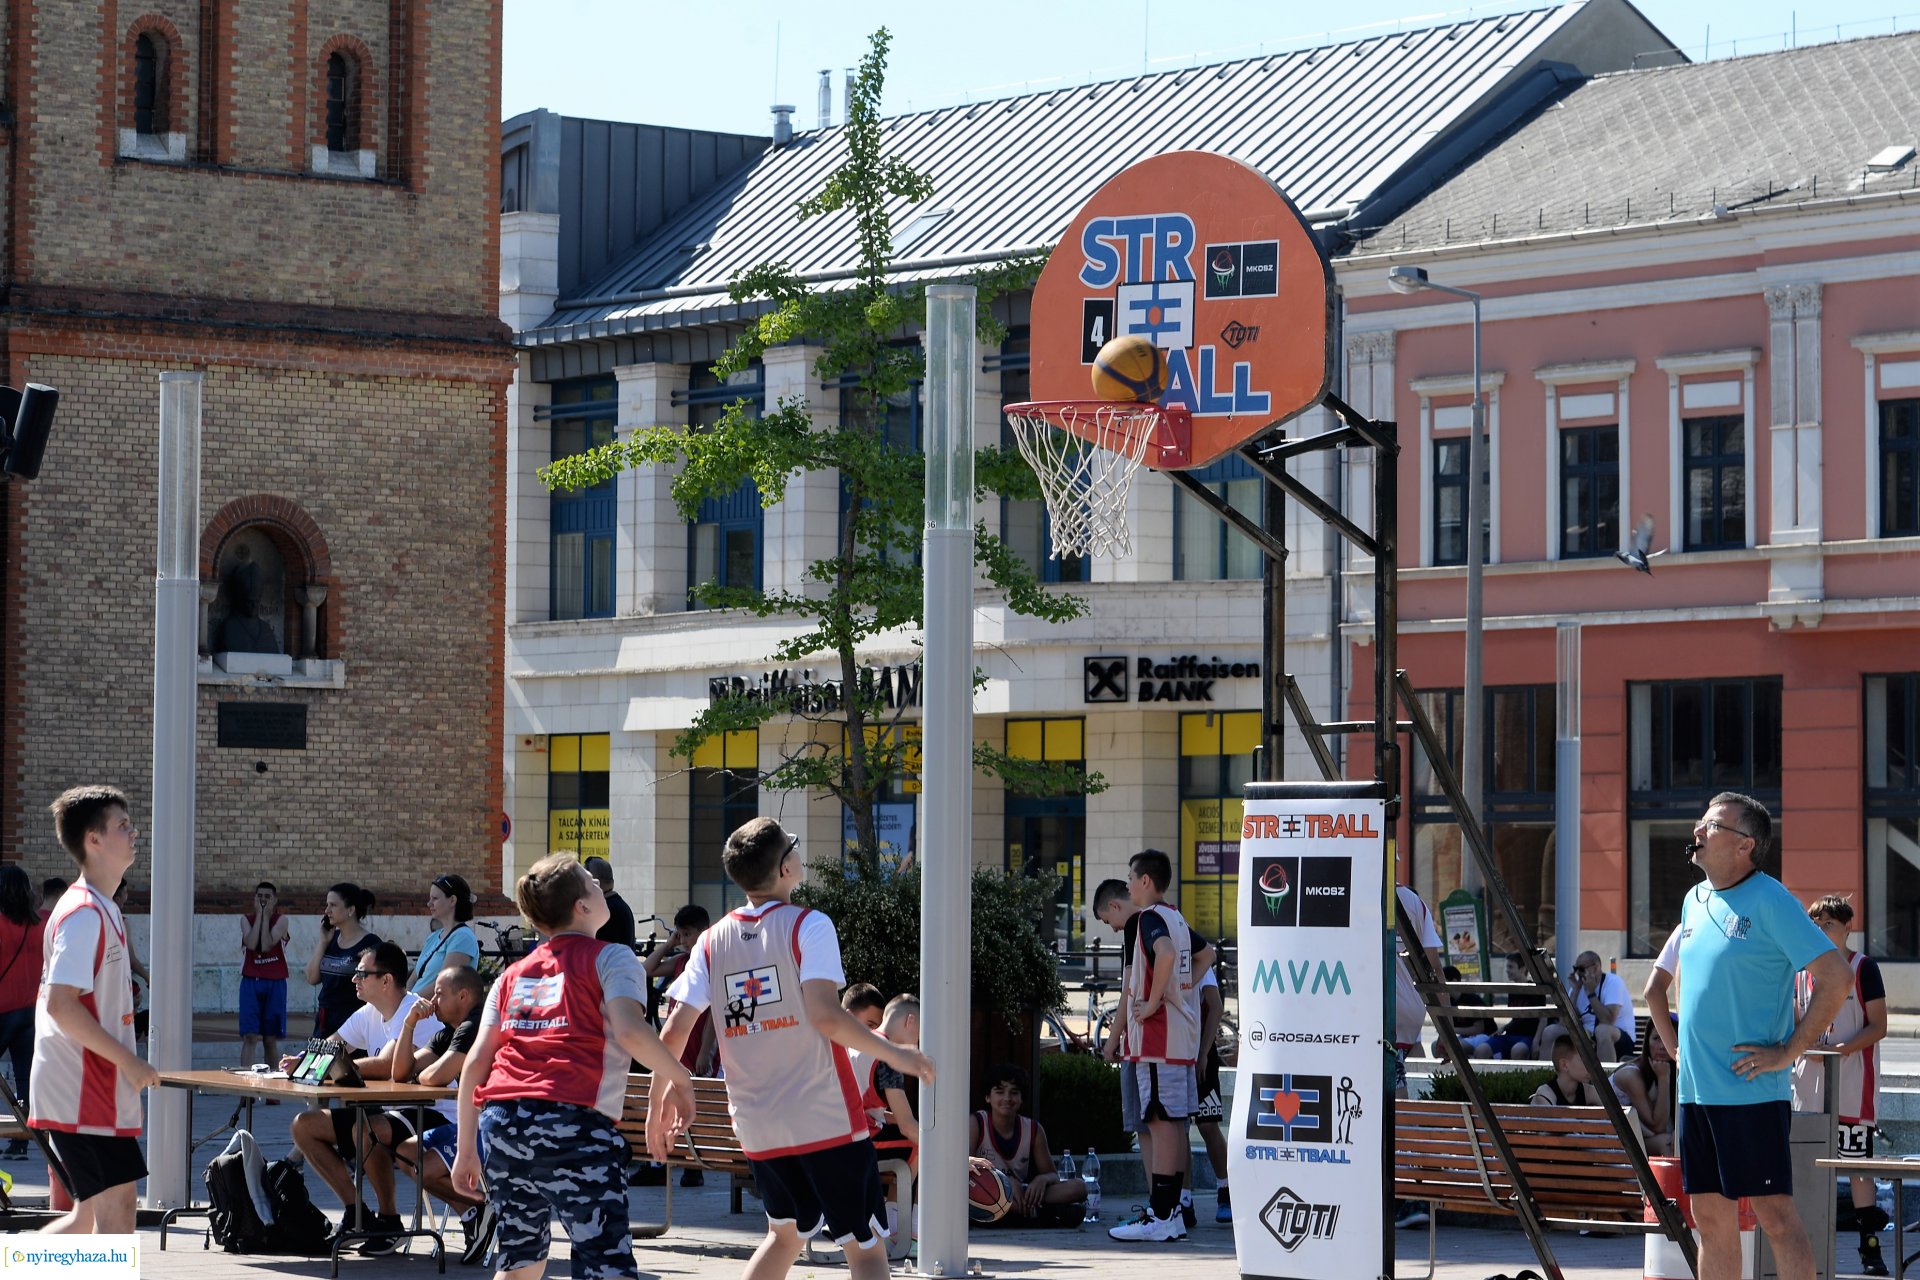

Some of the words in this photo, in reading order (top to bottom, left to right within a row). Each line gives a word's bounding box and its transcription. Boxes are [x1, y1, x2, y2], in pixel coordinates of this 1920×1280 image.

[1079, 213, 1196, 289] STR
[1246, 264, 1274, 273] MKOSZ
[1090, 316, 1105, 347] 4
[1229, 326, 1260, 343] TOTI
[1157, 345, 1272, 418] ALL
[1137, 655, 1260, 679] Raiffeisen
[1137, 681, 1215, 702] BANK
[1305, 887, 1345, 896] MKOSZ
[1252, 959, 1352, 996] MVM
[1269, 1033, 1360, 1044] GROSBASKET
[1276, 1201, 1341, 1240] TOTI
